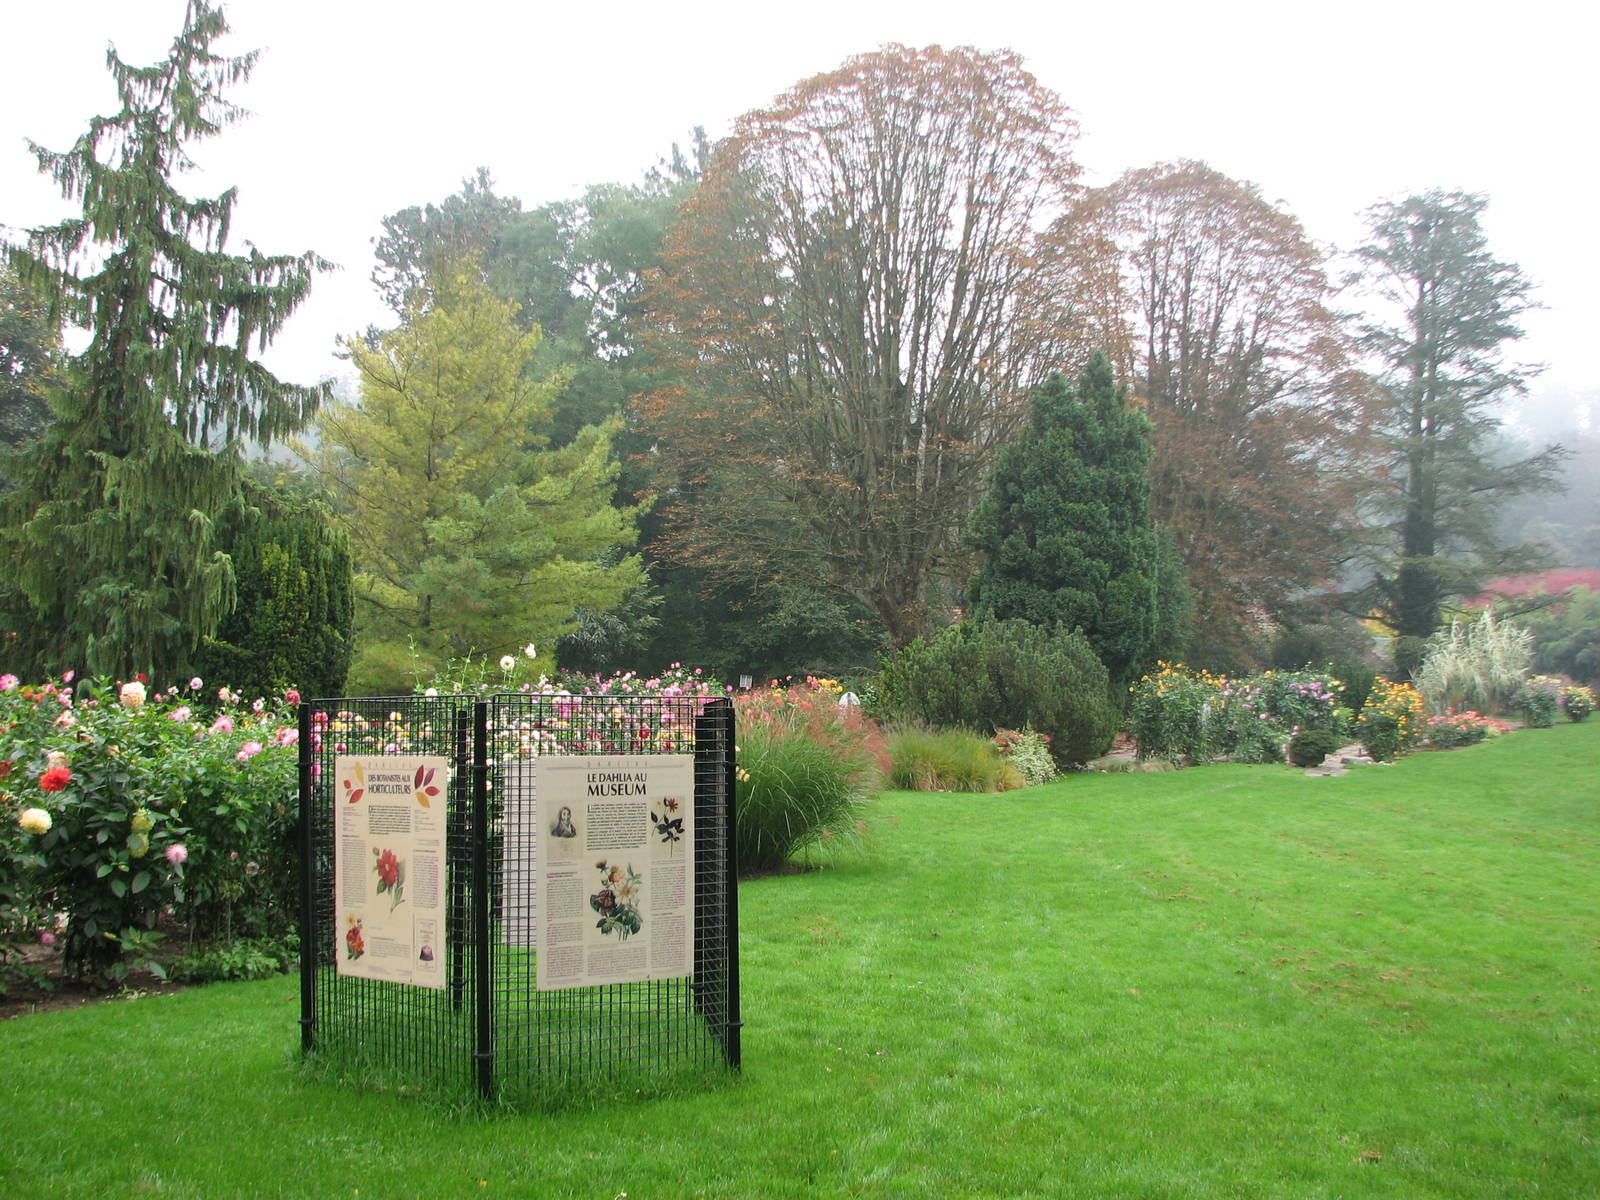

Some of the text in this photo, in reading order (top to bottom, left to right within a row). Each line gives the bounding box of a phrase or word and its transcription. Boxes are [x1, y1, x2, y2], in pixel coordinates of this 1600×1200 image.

[587, 772, 648, 783] LE DAHLIA AU
[368, 784, 412, 794] HORTICULTEURS
[587, 783, 647, 797] MUSEUM
